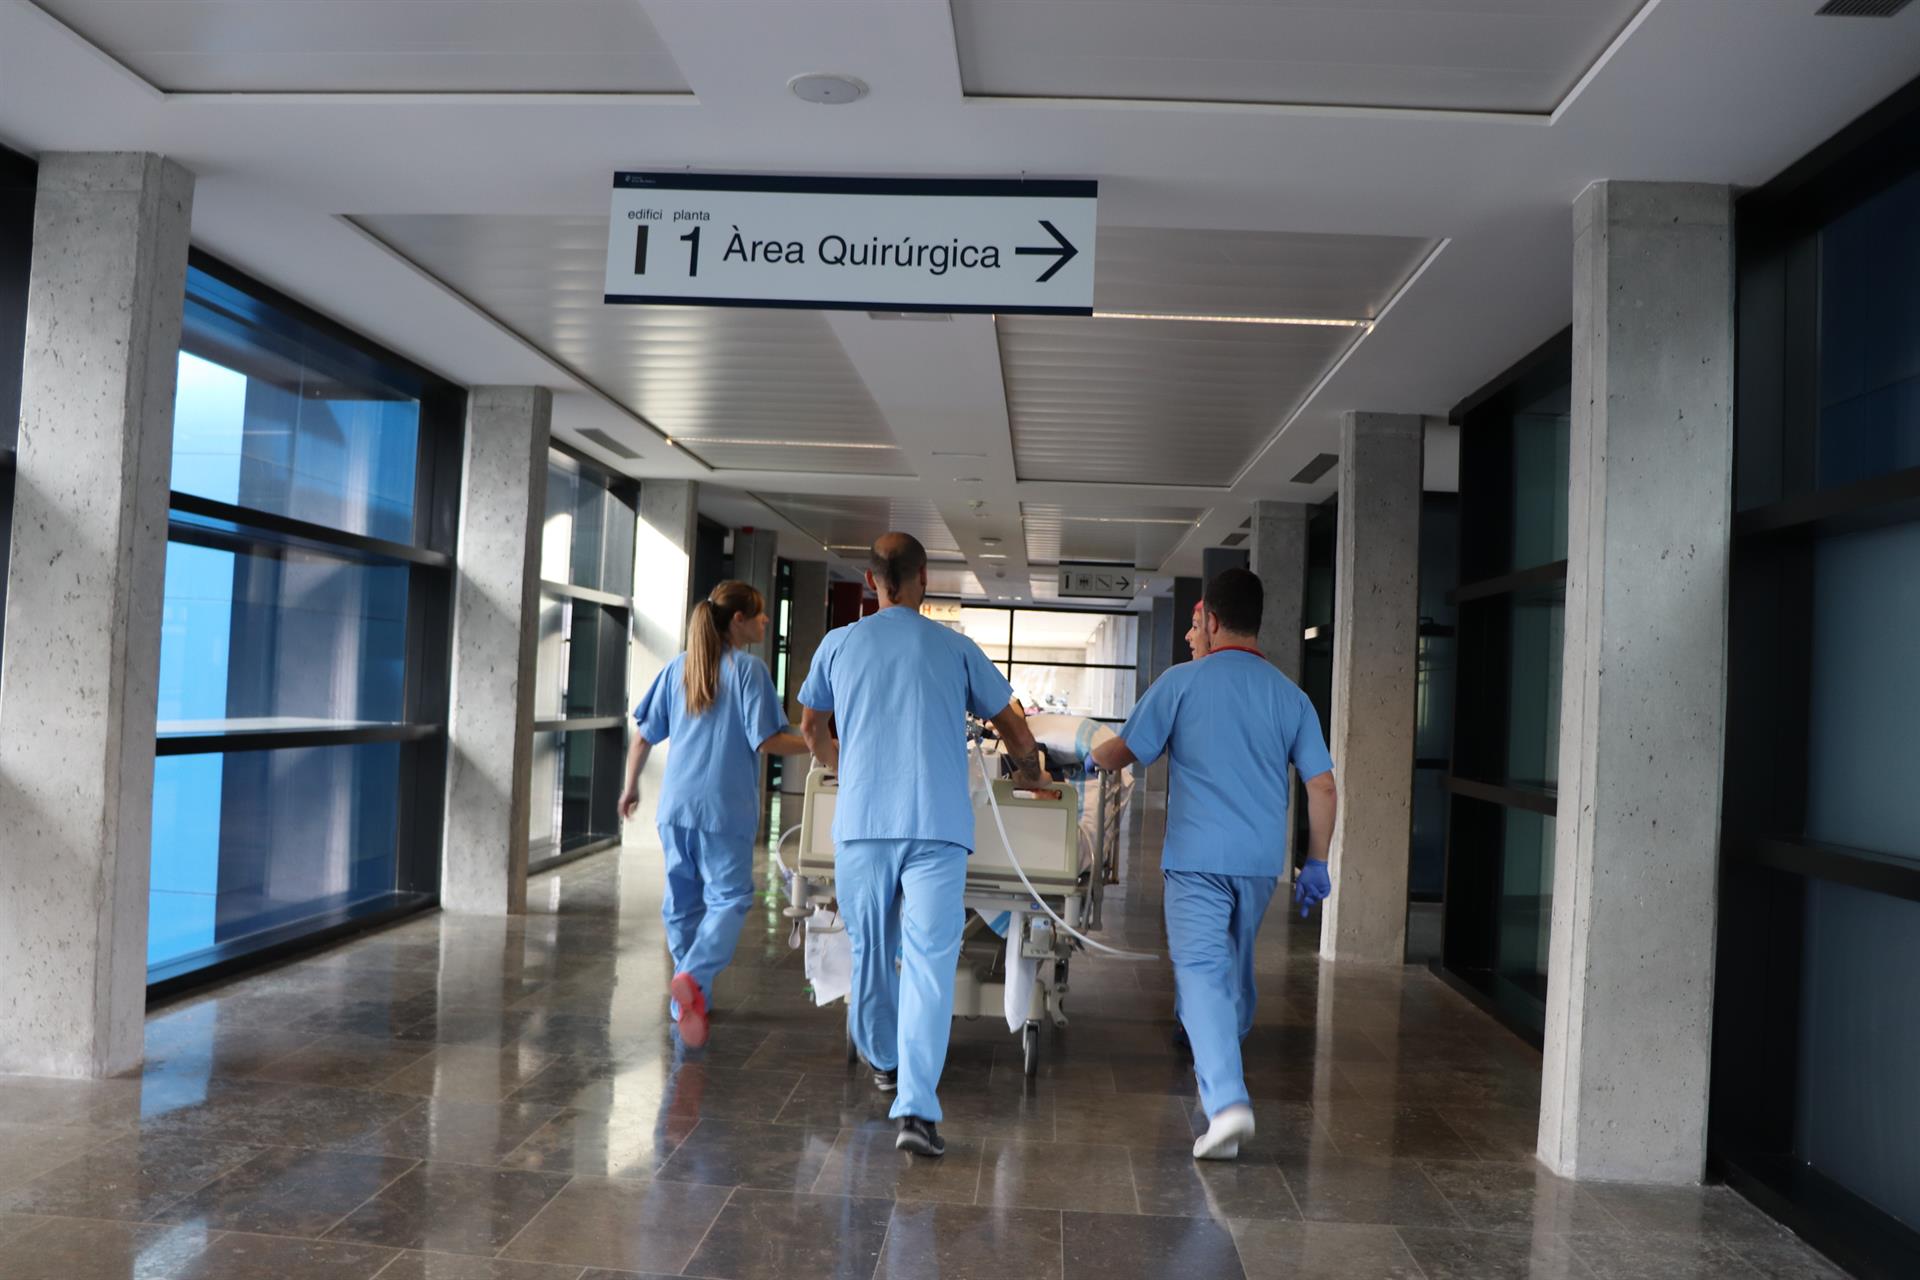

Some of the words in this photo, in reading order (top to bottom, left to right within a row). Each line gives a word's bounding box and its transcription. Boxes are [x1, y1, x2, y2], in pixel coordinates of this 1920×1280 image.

[627, 209, 663, 221] edifici
[673, 210, 711, 223] planta
[680, 226, 701, 278] 1
[723, 224, 805, 265] Àrea
[819, 234, 1001, 277] Quirúrgica
